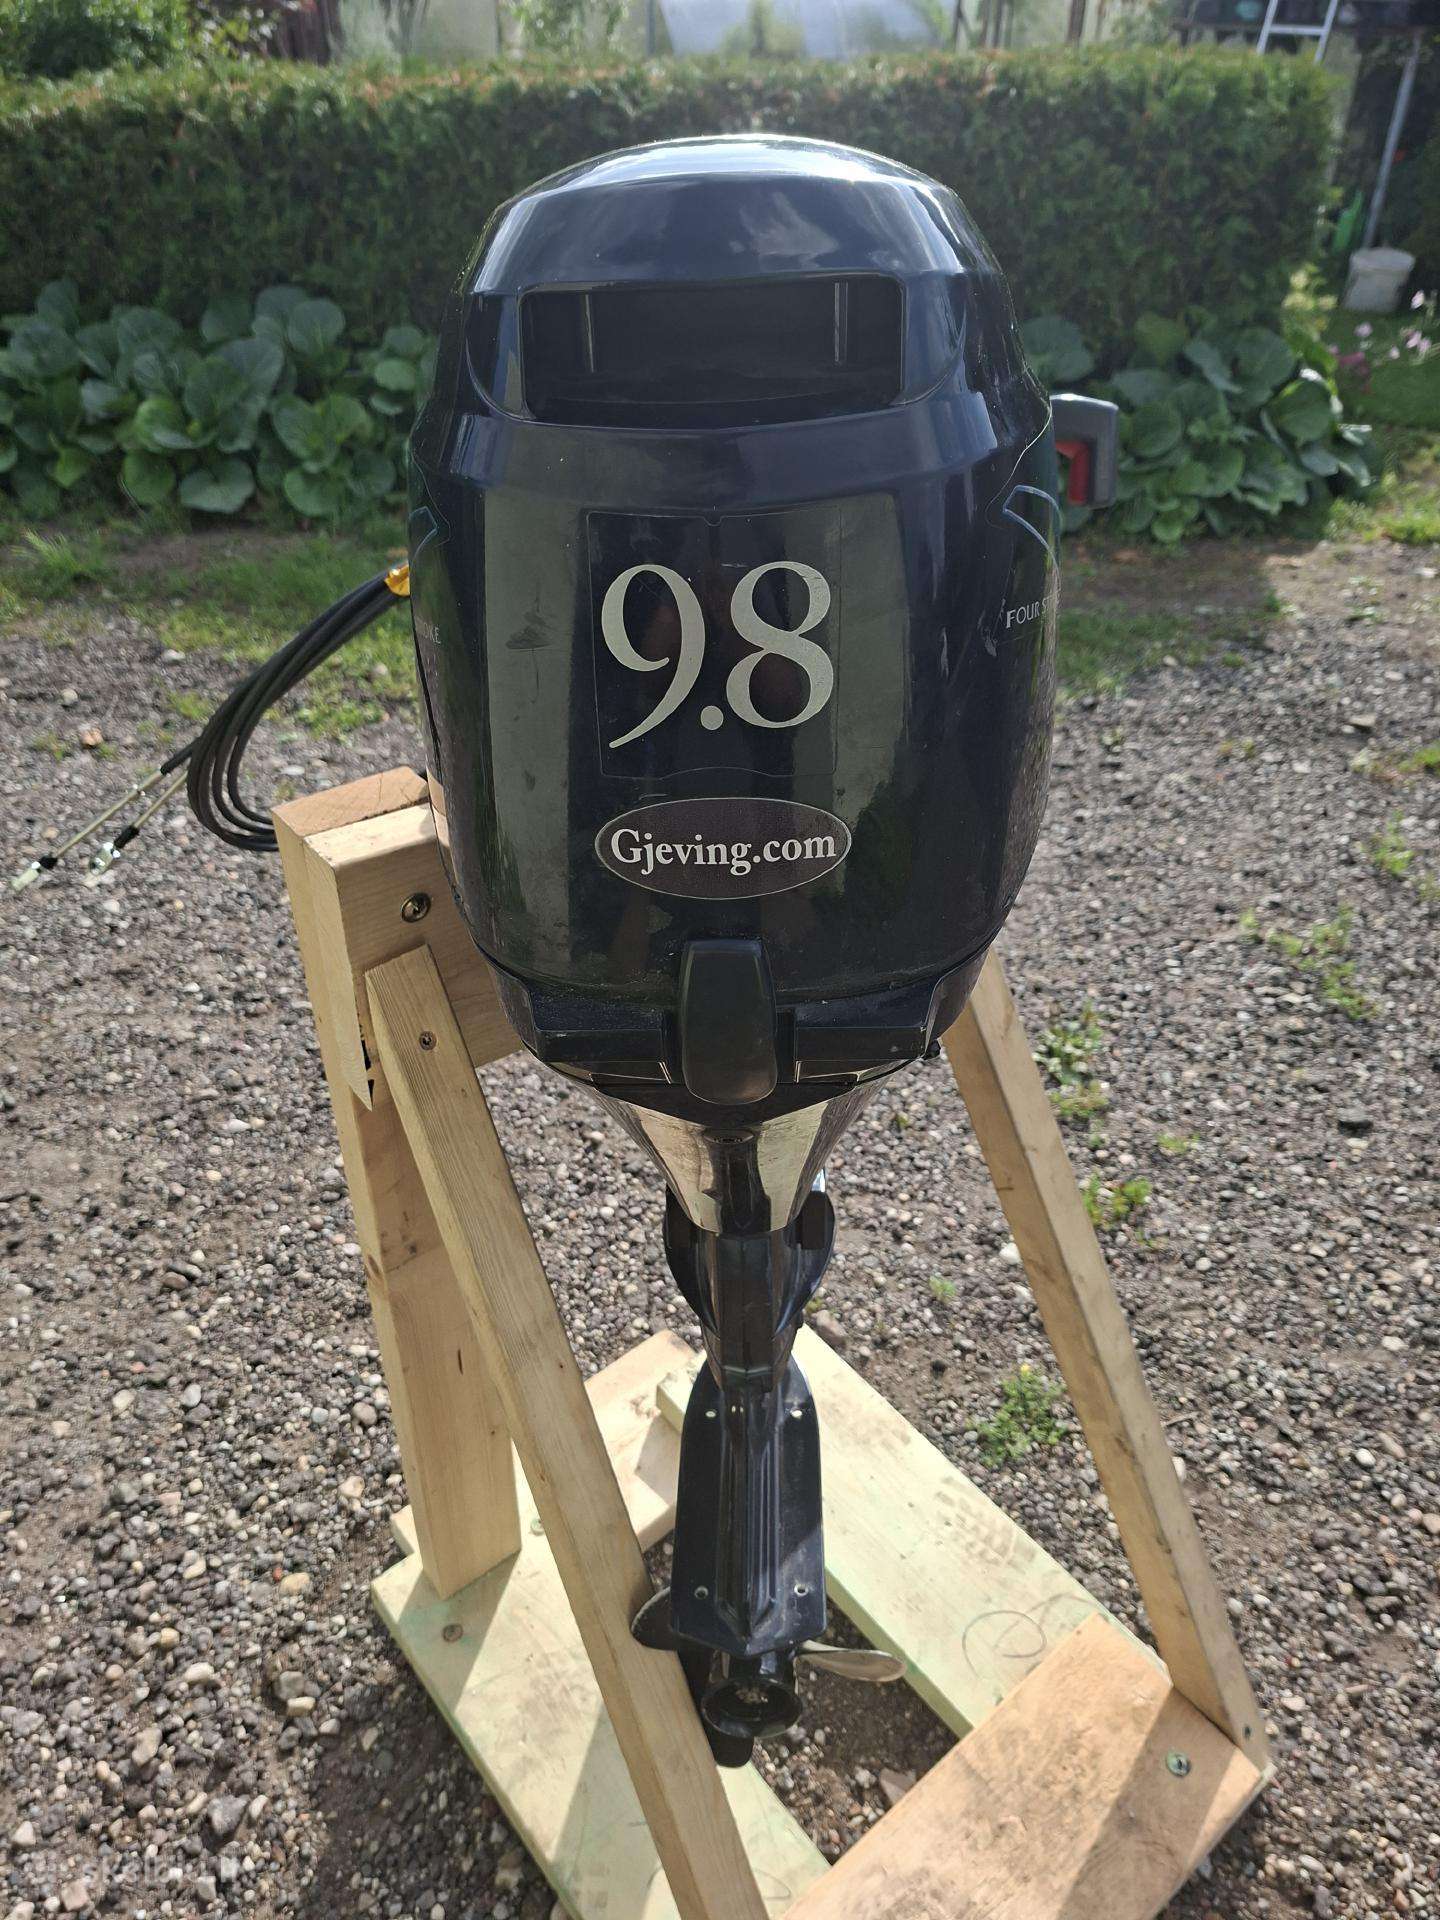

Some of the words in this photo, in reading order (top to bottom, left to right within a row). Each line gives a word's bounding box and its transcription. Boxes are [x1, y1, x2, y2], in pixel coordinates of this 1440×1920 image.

[1005, 601, 1041, 629] FOUR
[601, 561, 834, 748] 9.8
[610, 828, 837, 875] Gjeving.com
